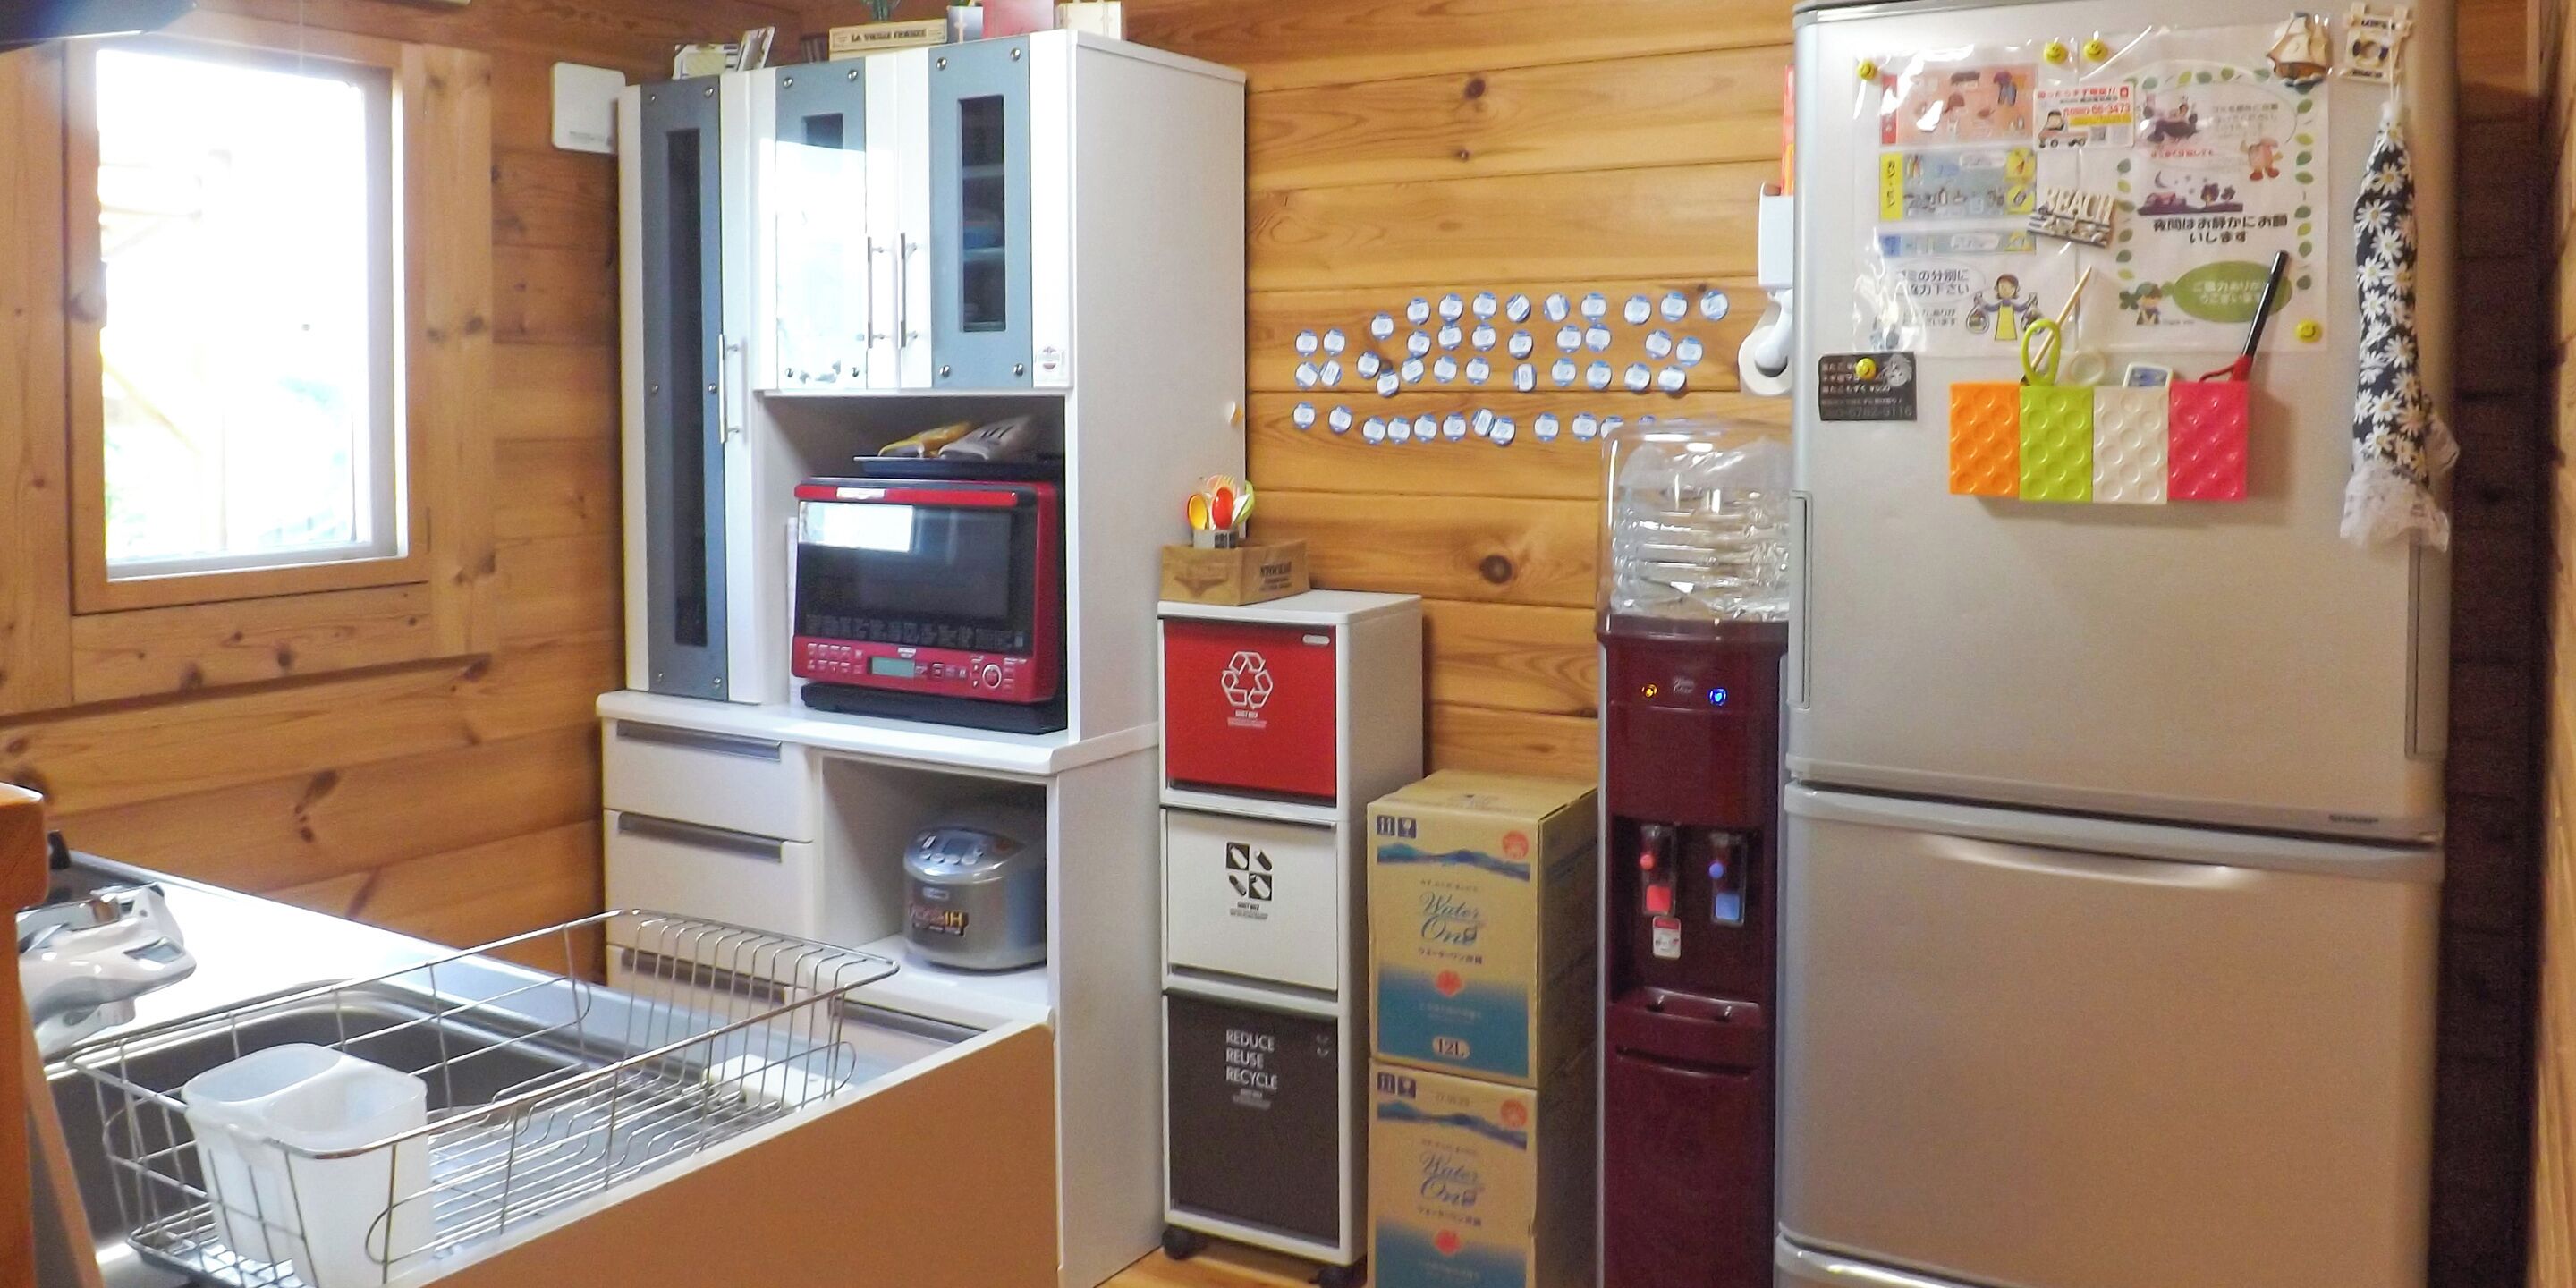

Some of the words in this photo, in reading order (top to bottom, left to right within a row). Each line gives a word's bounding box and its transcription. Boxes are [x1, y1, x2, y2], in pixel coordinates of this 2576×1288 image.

[2153, 213, 2288, 232] 夜間はお静かにお願
[2189, 231, 2248, 244] いします
[1419, 891, 1479, 919] Water
[1420, 915, 1479, 945] One
[1225, 1029, 1275, 1052] REDUCE
[1437, 1038, 1465, 1057] 12L
[1225, 1047, 1264, 1069] REUSE
[1225, 1066, 1278, 1090] RECYCLE
[1420, 1150, 1479, 1183] Water
[1420, 1177, 1477, 1207] One
